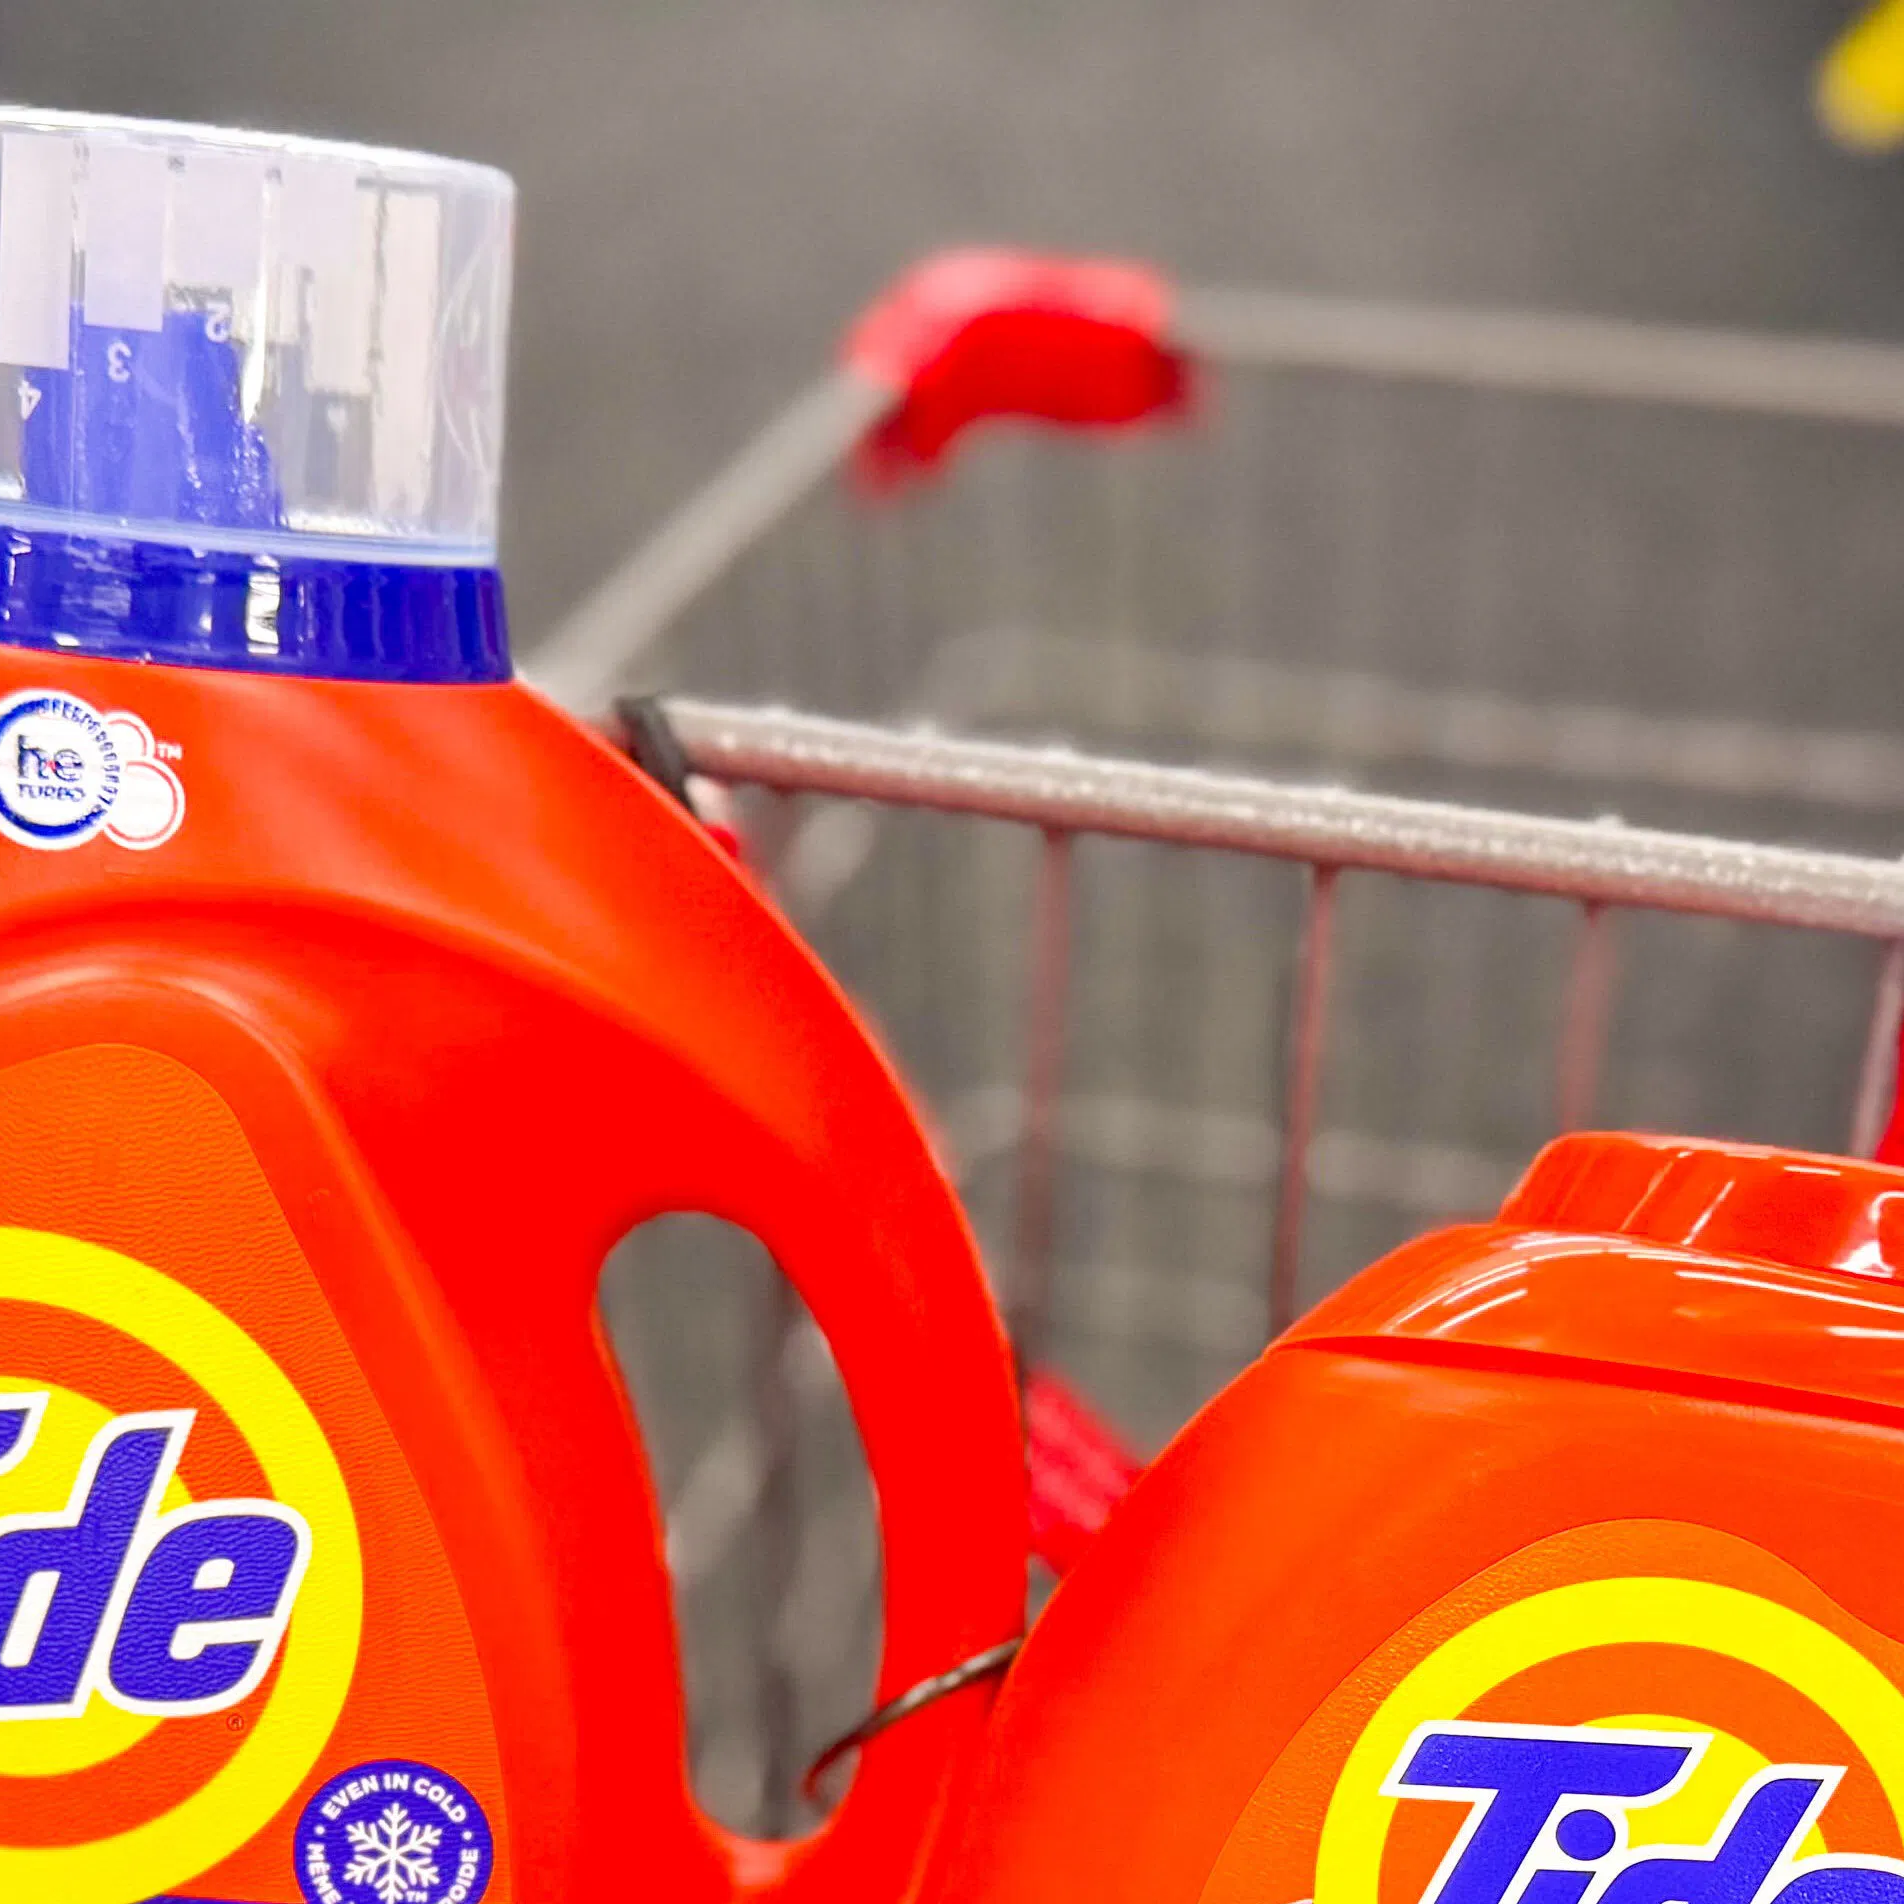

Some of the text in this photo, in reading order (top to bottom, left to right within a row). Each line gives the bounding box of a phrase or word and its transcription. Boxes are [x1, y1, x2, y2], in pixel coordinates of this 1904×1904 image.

[107, 342, 132, 381] 3
[321, 1773, 467, 1823] EVEN IN COLD
